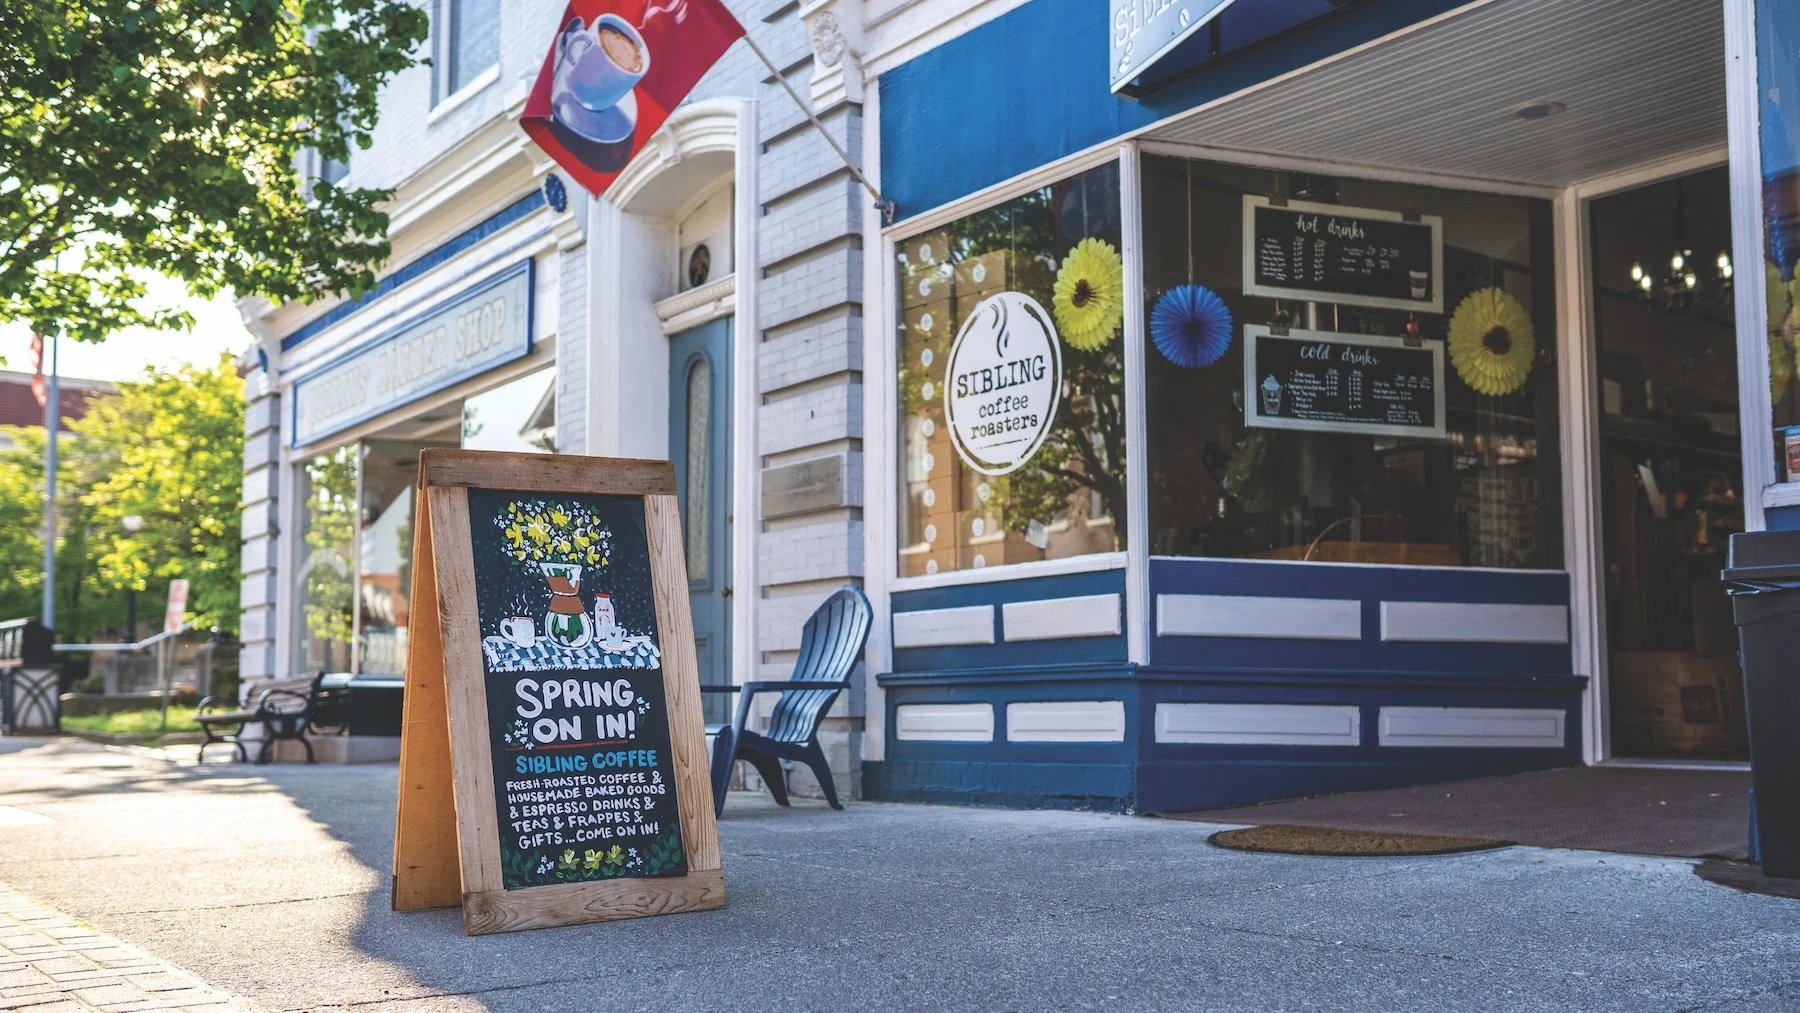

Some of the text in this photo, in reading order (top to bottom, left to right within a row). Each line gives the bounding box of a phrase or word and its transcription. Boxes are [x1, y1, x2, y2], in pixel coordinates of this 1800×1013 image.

[1296, 214, 1365, 240] hot drinks
[455, 298, 506, 362] SHOP
[1300, 344, 1380, 366] cold drinks
[957, 355, 1046, 399] SIBLING
[978, 395, 1029, 419] coffee
[970, 414, 1038, 440] roasters
[515, 678, 635, 719] SPRING
[532, 710, 636, 743] ON IN!
[516, 750, 658, 773] SIBLING COFFEE
[506, 770, 663, 792] FRESH-ROASTED COFFEE &
[508, 784, 666, 805] HOUSEMADE BAKED GOODS
[509, 796, 656, 819] & ESPRESSO DRINKS &
[512, 811, 644, 834] TEAS & FRAPPES &
[617, 825, 637, 837] ON
[640, 821, 660, 836] IN!
